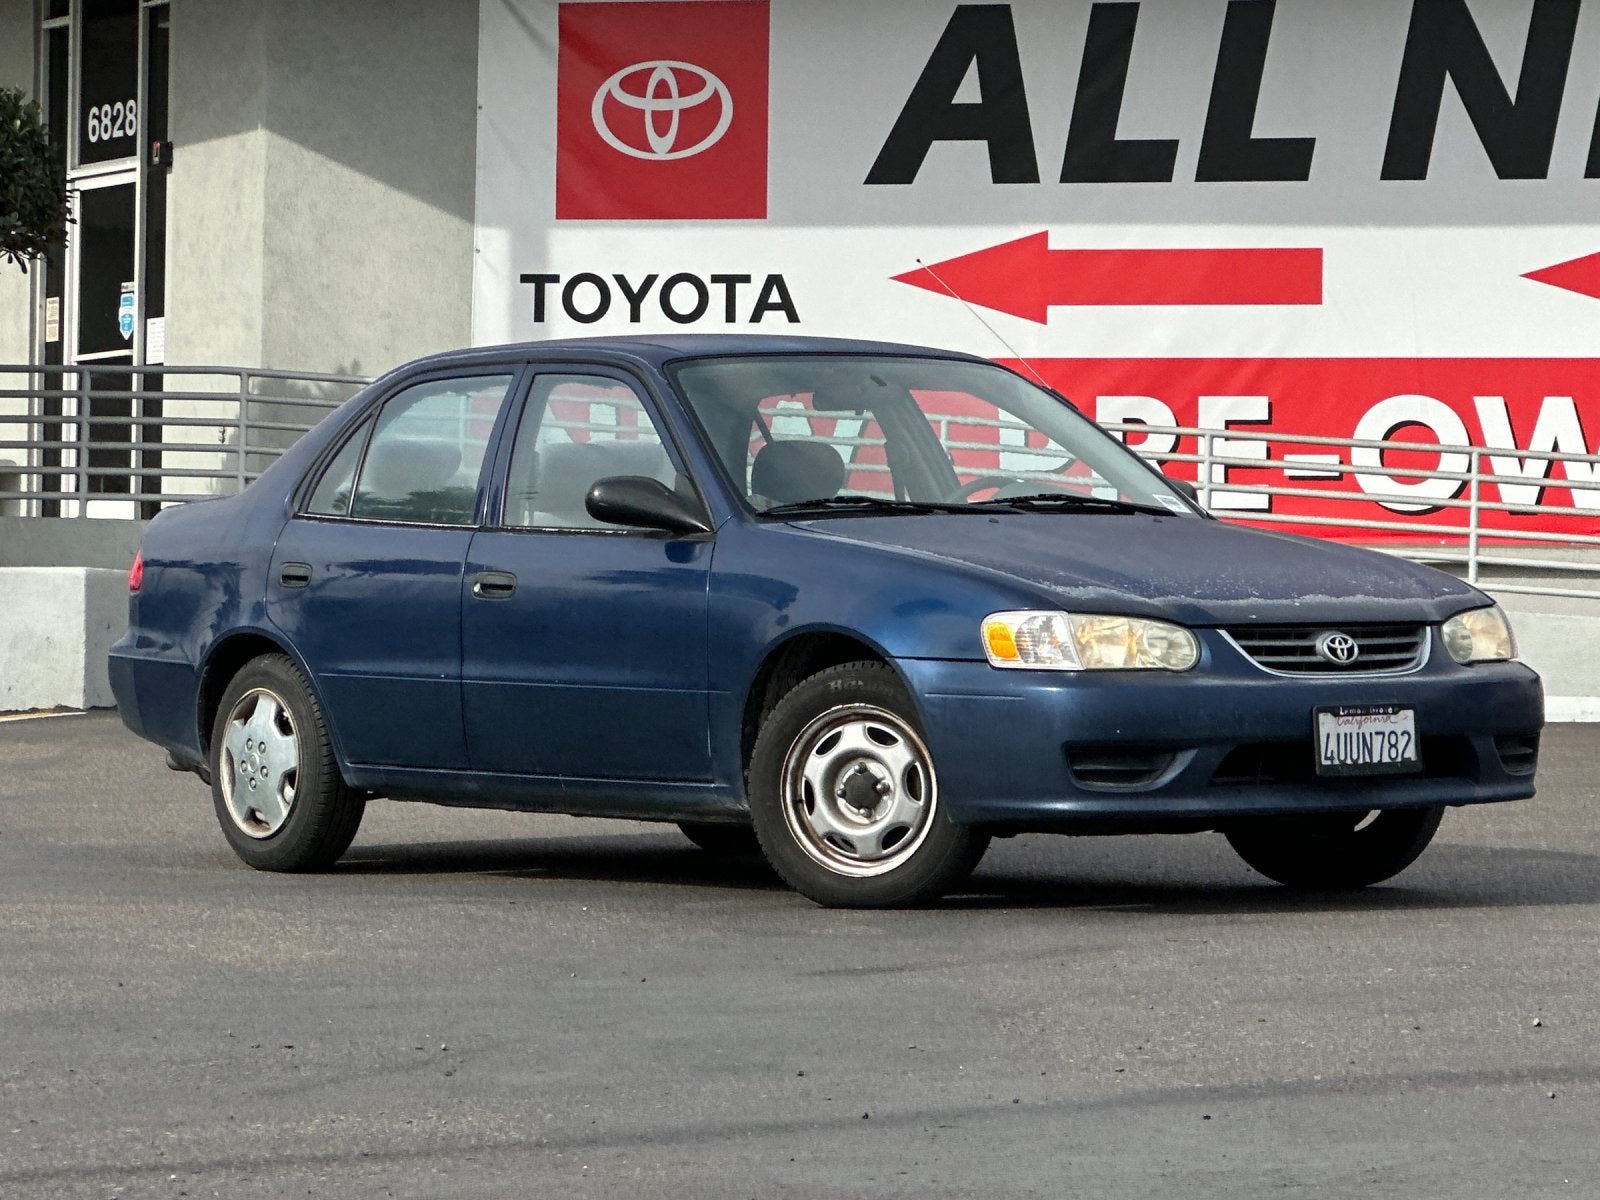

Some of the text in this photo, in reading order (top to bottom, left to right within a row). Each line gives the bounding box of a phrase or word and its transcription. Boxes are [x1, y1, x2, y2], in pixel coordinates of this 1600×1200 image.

[862, 0, 1600, 185] ALL N
[87, 99, 137, 143] 6828
[519, 272, 801, 324] TOYOTA
[1323, 730, 1411, 765] 4UUN782
